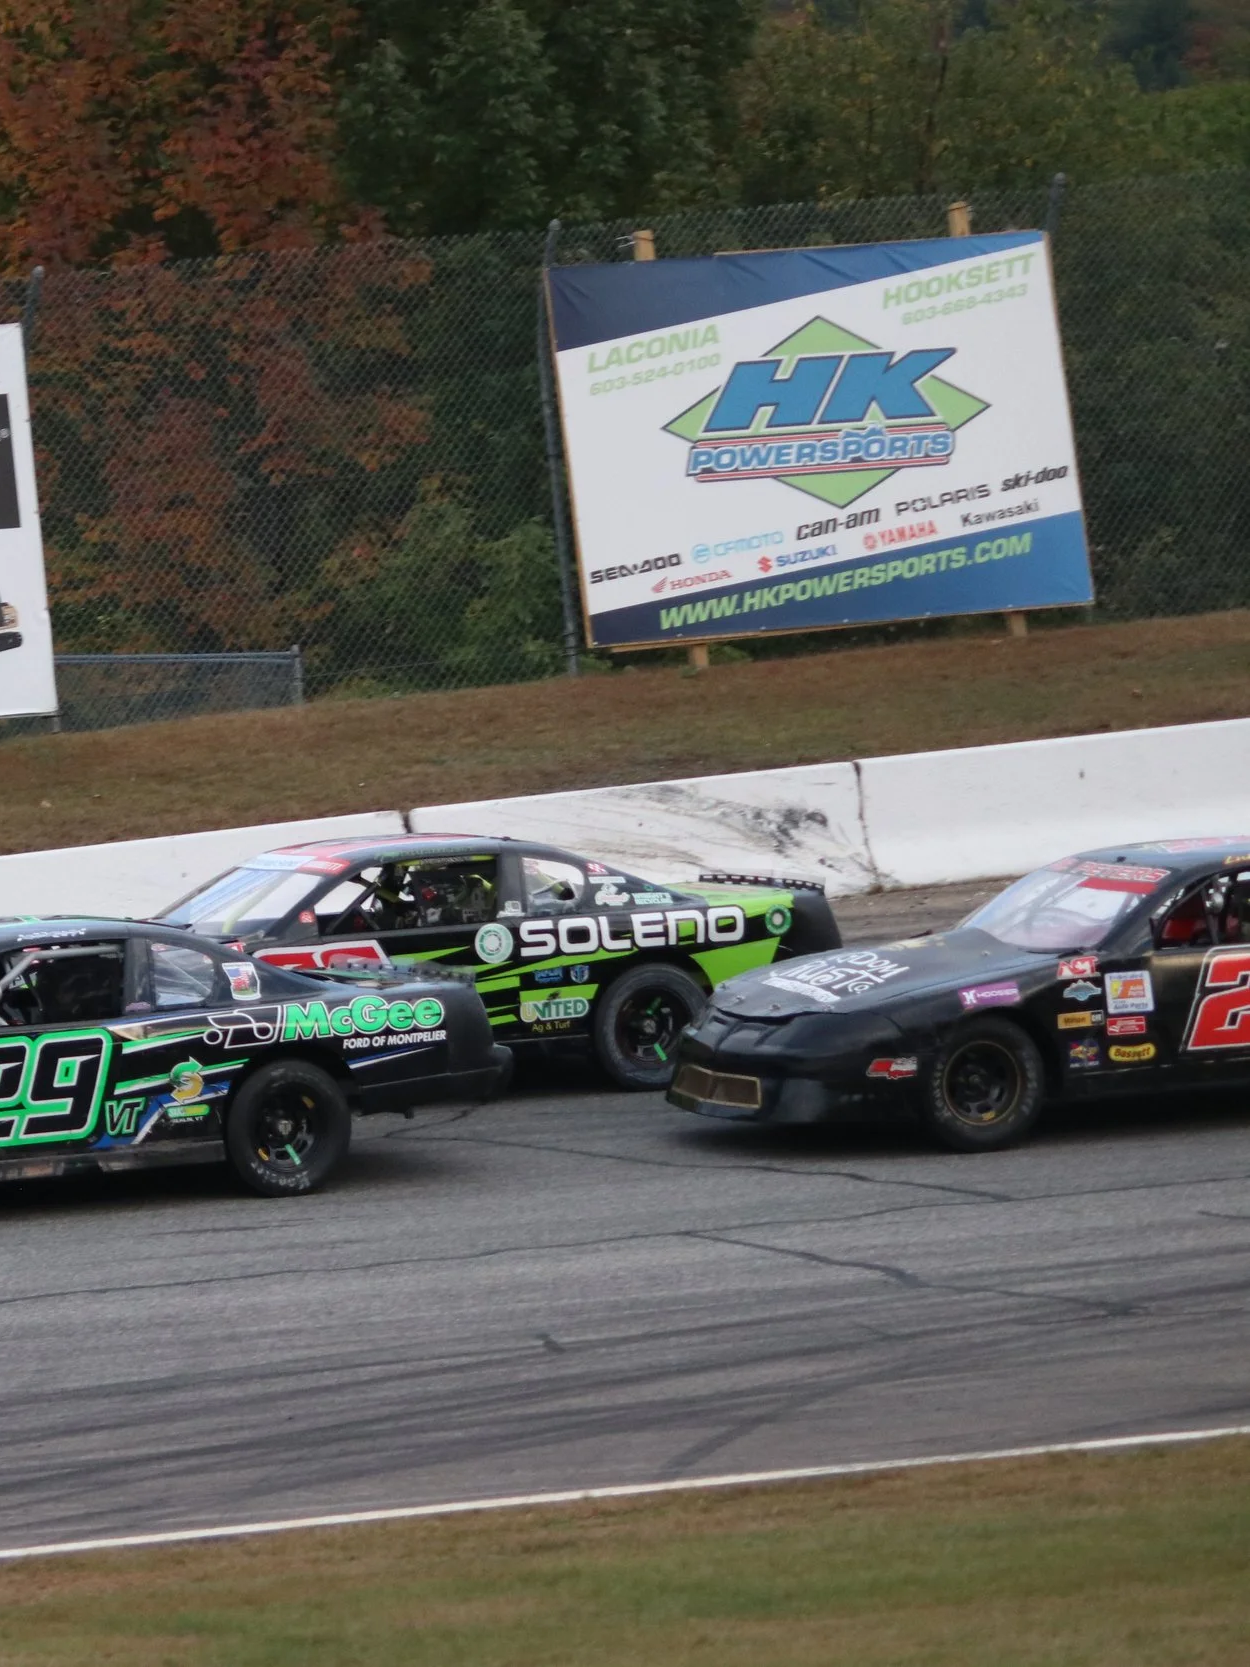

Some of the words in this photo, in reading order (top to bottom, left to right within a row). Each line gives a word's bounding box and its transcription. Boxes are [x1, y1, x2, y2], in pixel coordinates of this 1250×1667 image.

[883, 252, 1035, 309] HOOKSETT
[587, 324, 720, 374] LACONIA
[590, 353, 721, 396] 603-524-0100
[701, 347, 958, 433] HK
[688, 430, 953, 474] POWERSPORTS
[895, 484, 991, 516] POLARIS
[669, 569, 732, 590] HONDA
[774, 544, 838, 567] SUZUKI
[878, 520, 938, 546] YAMAHA
[960, 498, 1040, 527] Kawasaki
[659, 532, 1033, 630] WWW.HKPOWERSPORTS.COM
[519, 905, 745, 957] SOLENO
[521, 998, 589, 1022] UNITED
[975, 987, 1018, 1000] HOOSIER
[280, 995, 445, 1042] McGee
[343, 1037, 370, 1049] FORD
[372, 1036, 386, 1047] OF
[387, 1030, 447, 1046] MONTPELIER
[545, 1022, 552, 1030] &
[555, 1020, 570, 1029] Turf
[105, 1098, 148, 1137] VT
